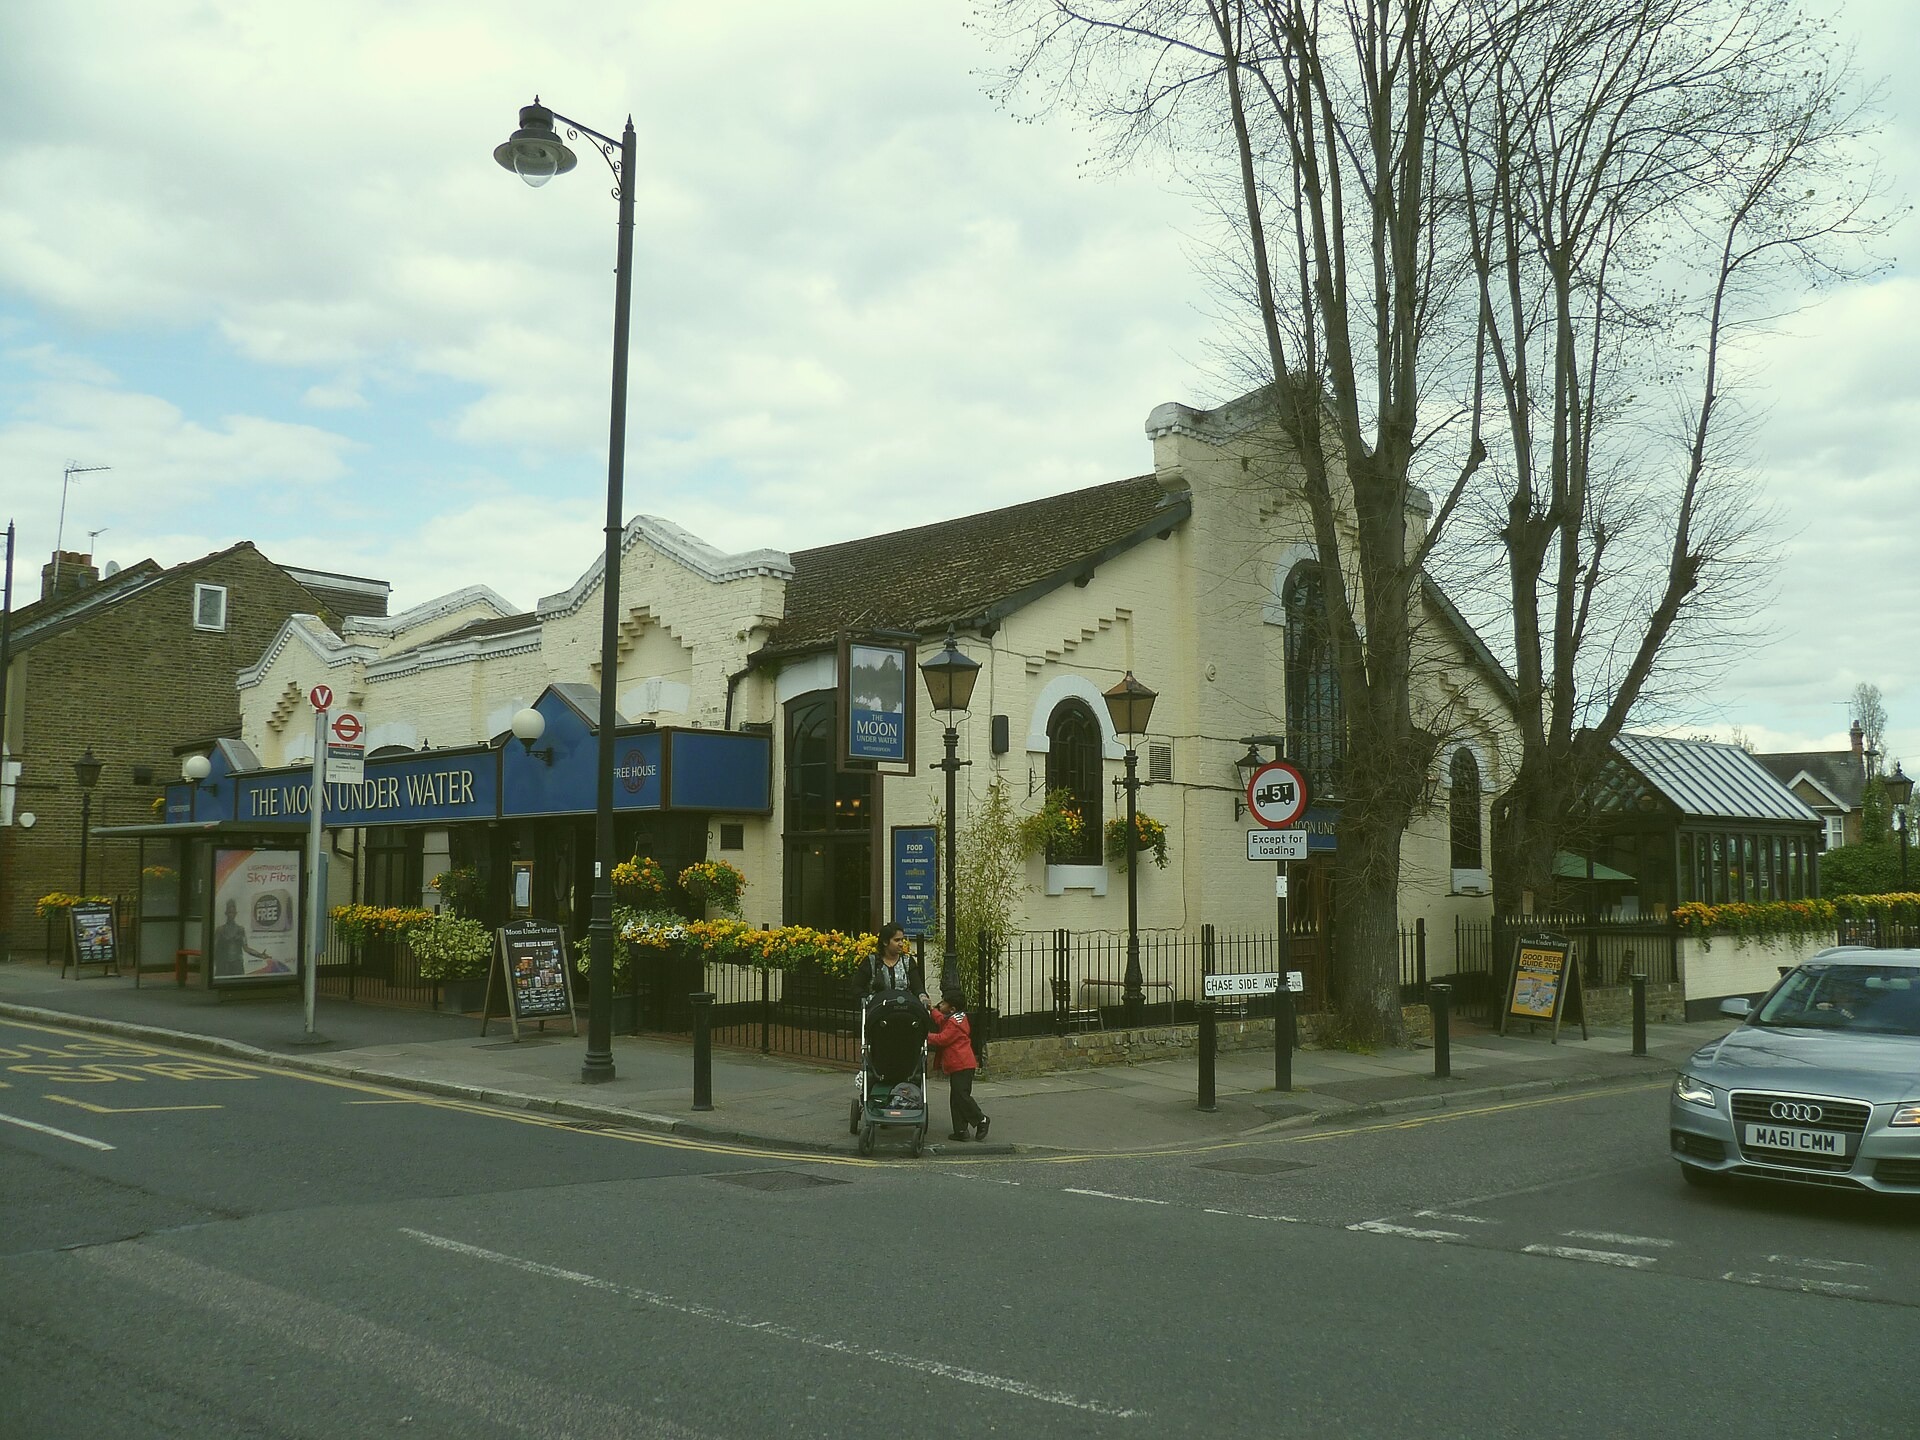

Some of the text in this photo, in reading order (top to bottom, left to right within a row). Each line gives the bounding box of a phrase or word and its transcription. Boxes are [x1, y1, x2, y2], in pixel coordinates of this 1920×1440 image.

[315, 688, 330, 706] V
[872, 714, 884, 722] THE
[856, 720, 898, 737] MOON
[856, 735, 898, 745] UNDER WATER
[631, 764, 657, 777] HOUSE
[250, 788, 278, 816] THE
[337, 777, 400, 811] UNDER
[406, 770, 475, 806] WATER
[1252, 834, 1303, 845] Except for
[1259, 845, 1295, 856] loading
[247, 872, 296, 885] Sky Fibre
[256, 907, 278, 921] FREE
[1206, 976, 1292, 991] CHASE SIDE AVEE
[7, 1062, 260, 1083] BUS
[1756, 1127, 1835, 1152] MA61 CMM
